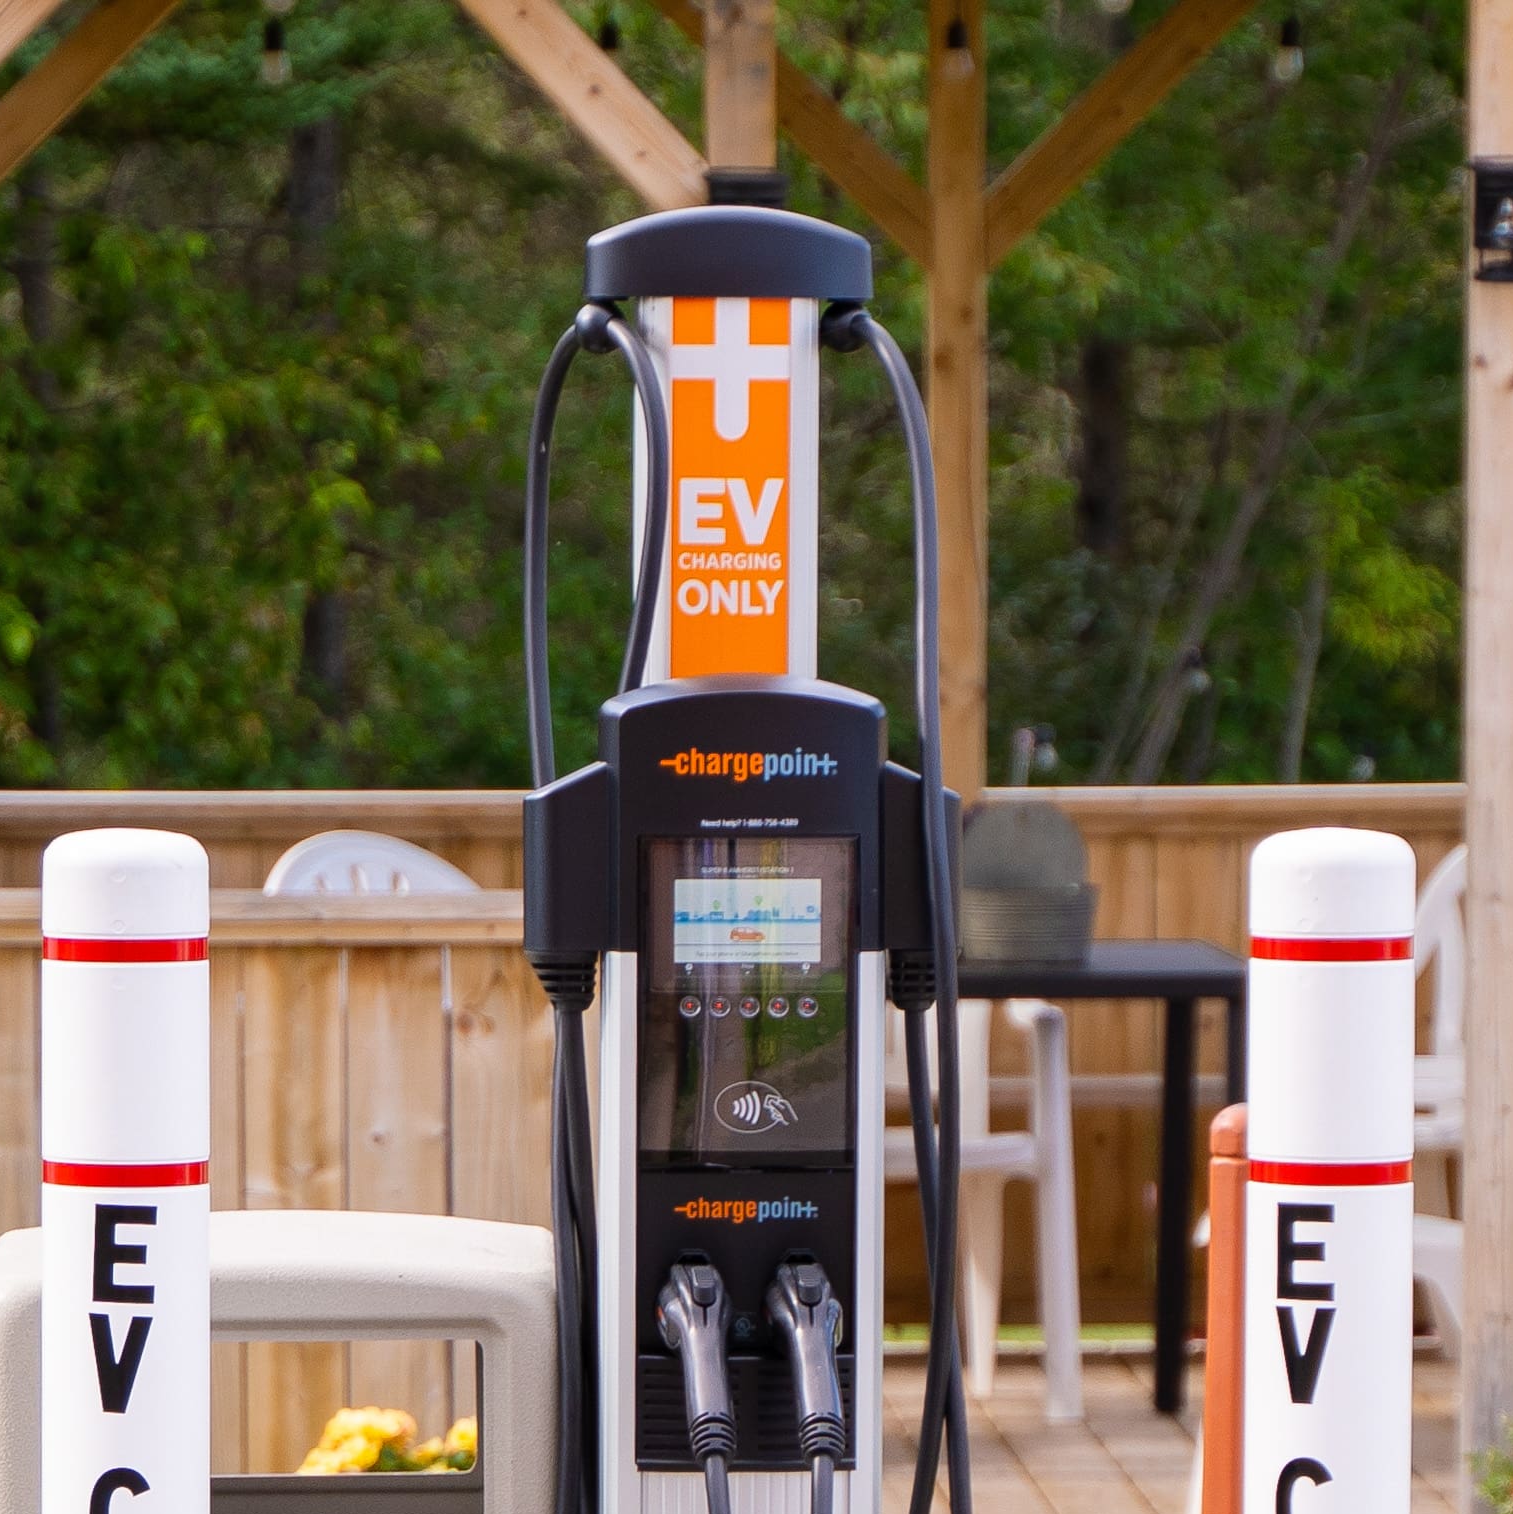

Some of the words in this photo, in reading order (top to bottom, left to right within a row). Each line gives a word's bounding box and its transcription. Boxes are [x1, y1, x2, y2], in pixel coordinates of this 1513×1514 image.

[679, 478, 783, 545] EV
[679, 552, 782, 570] CHARGING
[677, 579, 783, 615] ONLY
[90, 1204, 157, 1414] EV
[1276, 1203, 1336, 1404] EV
